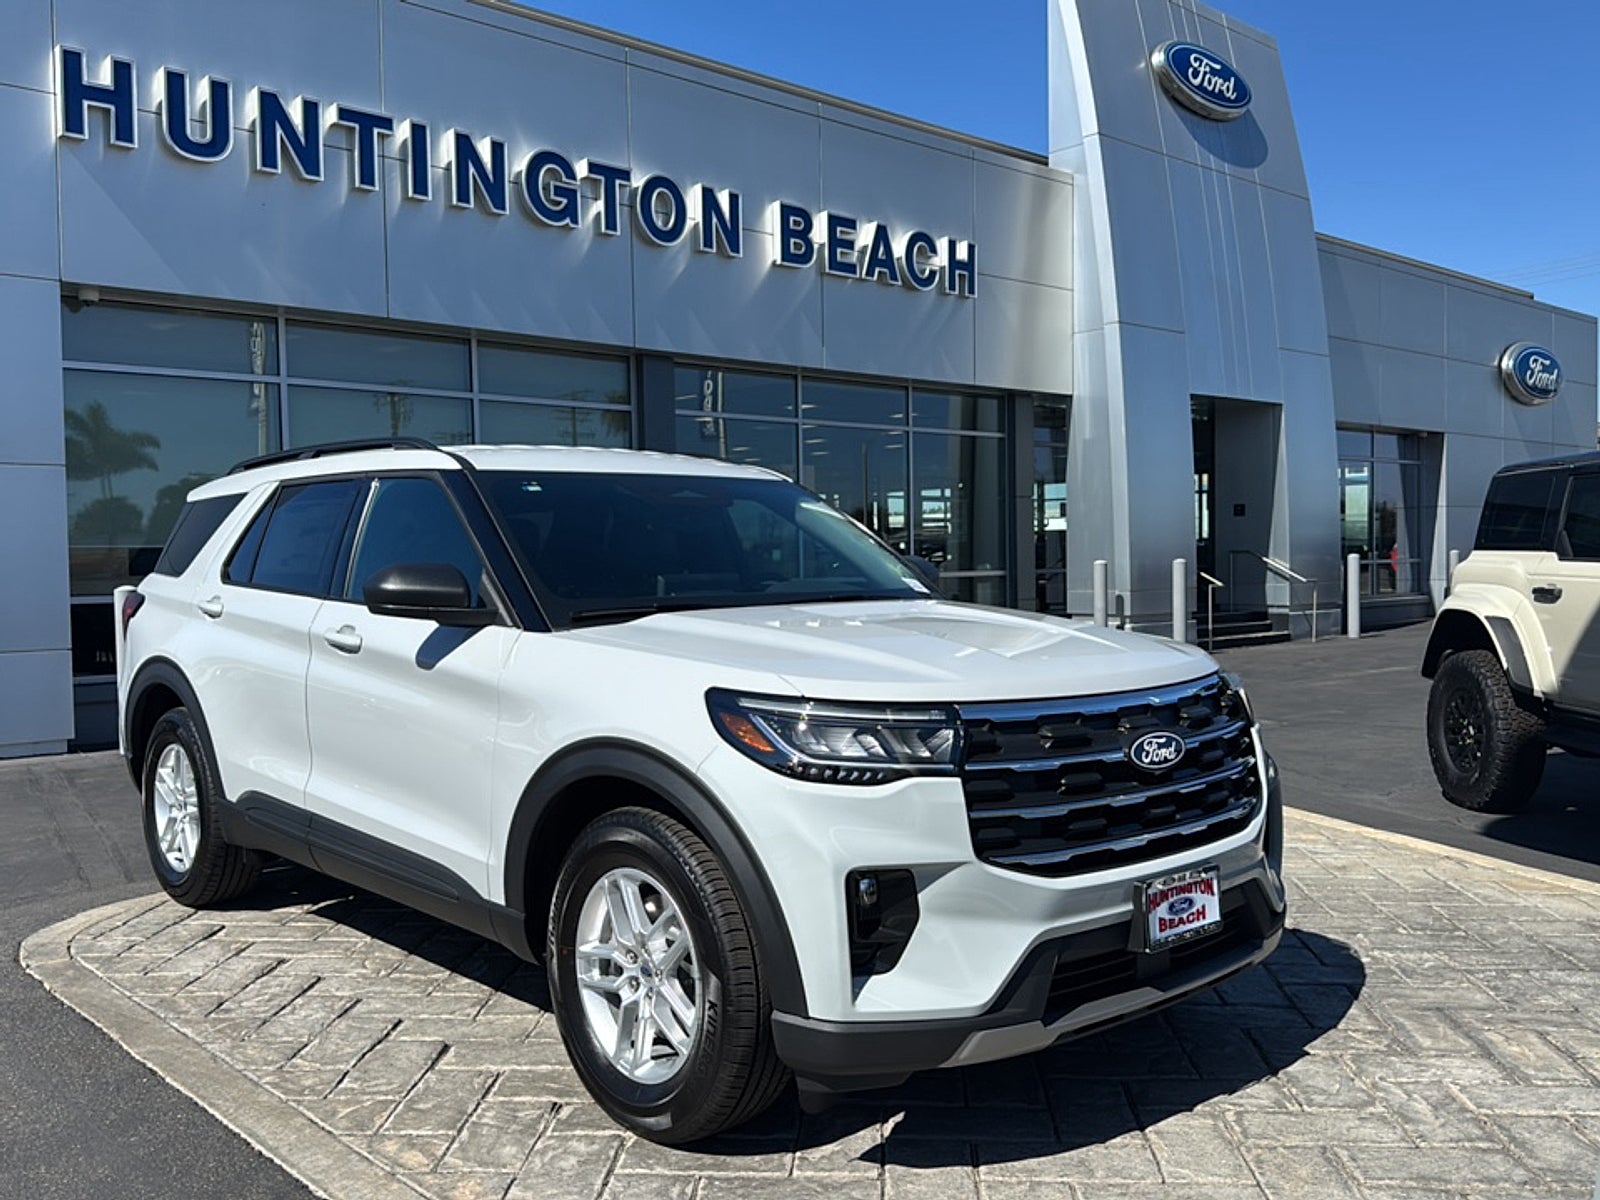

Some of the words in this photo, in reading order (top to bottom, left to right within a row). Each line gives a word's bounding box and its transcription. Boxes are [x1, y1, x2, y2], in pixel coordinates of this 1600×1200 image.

[1188, 53, 1237, 100] Ford
[55, 44, 743, 258] HUNTINGTON
[773, 200, 978, 298] BEACH
[1526, 355, 1558, 390] Ford
[1142, 737, 1177, 763] Ford
[1148, 876, 1216, 915] HUNTINGTON
[1158, 904, 1207, 933] BEACH
